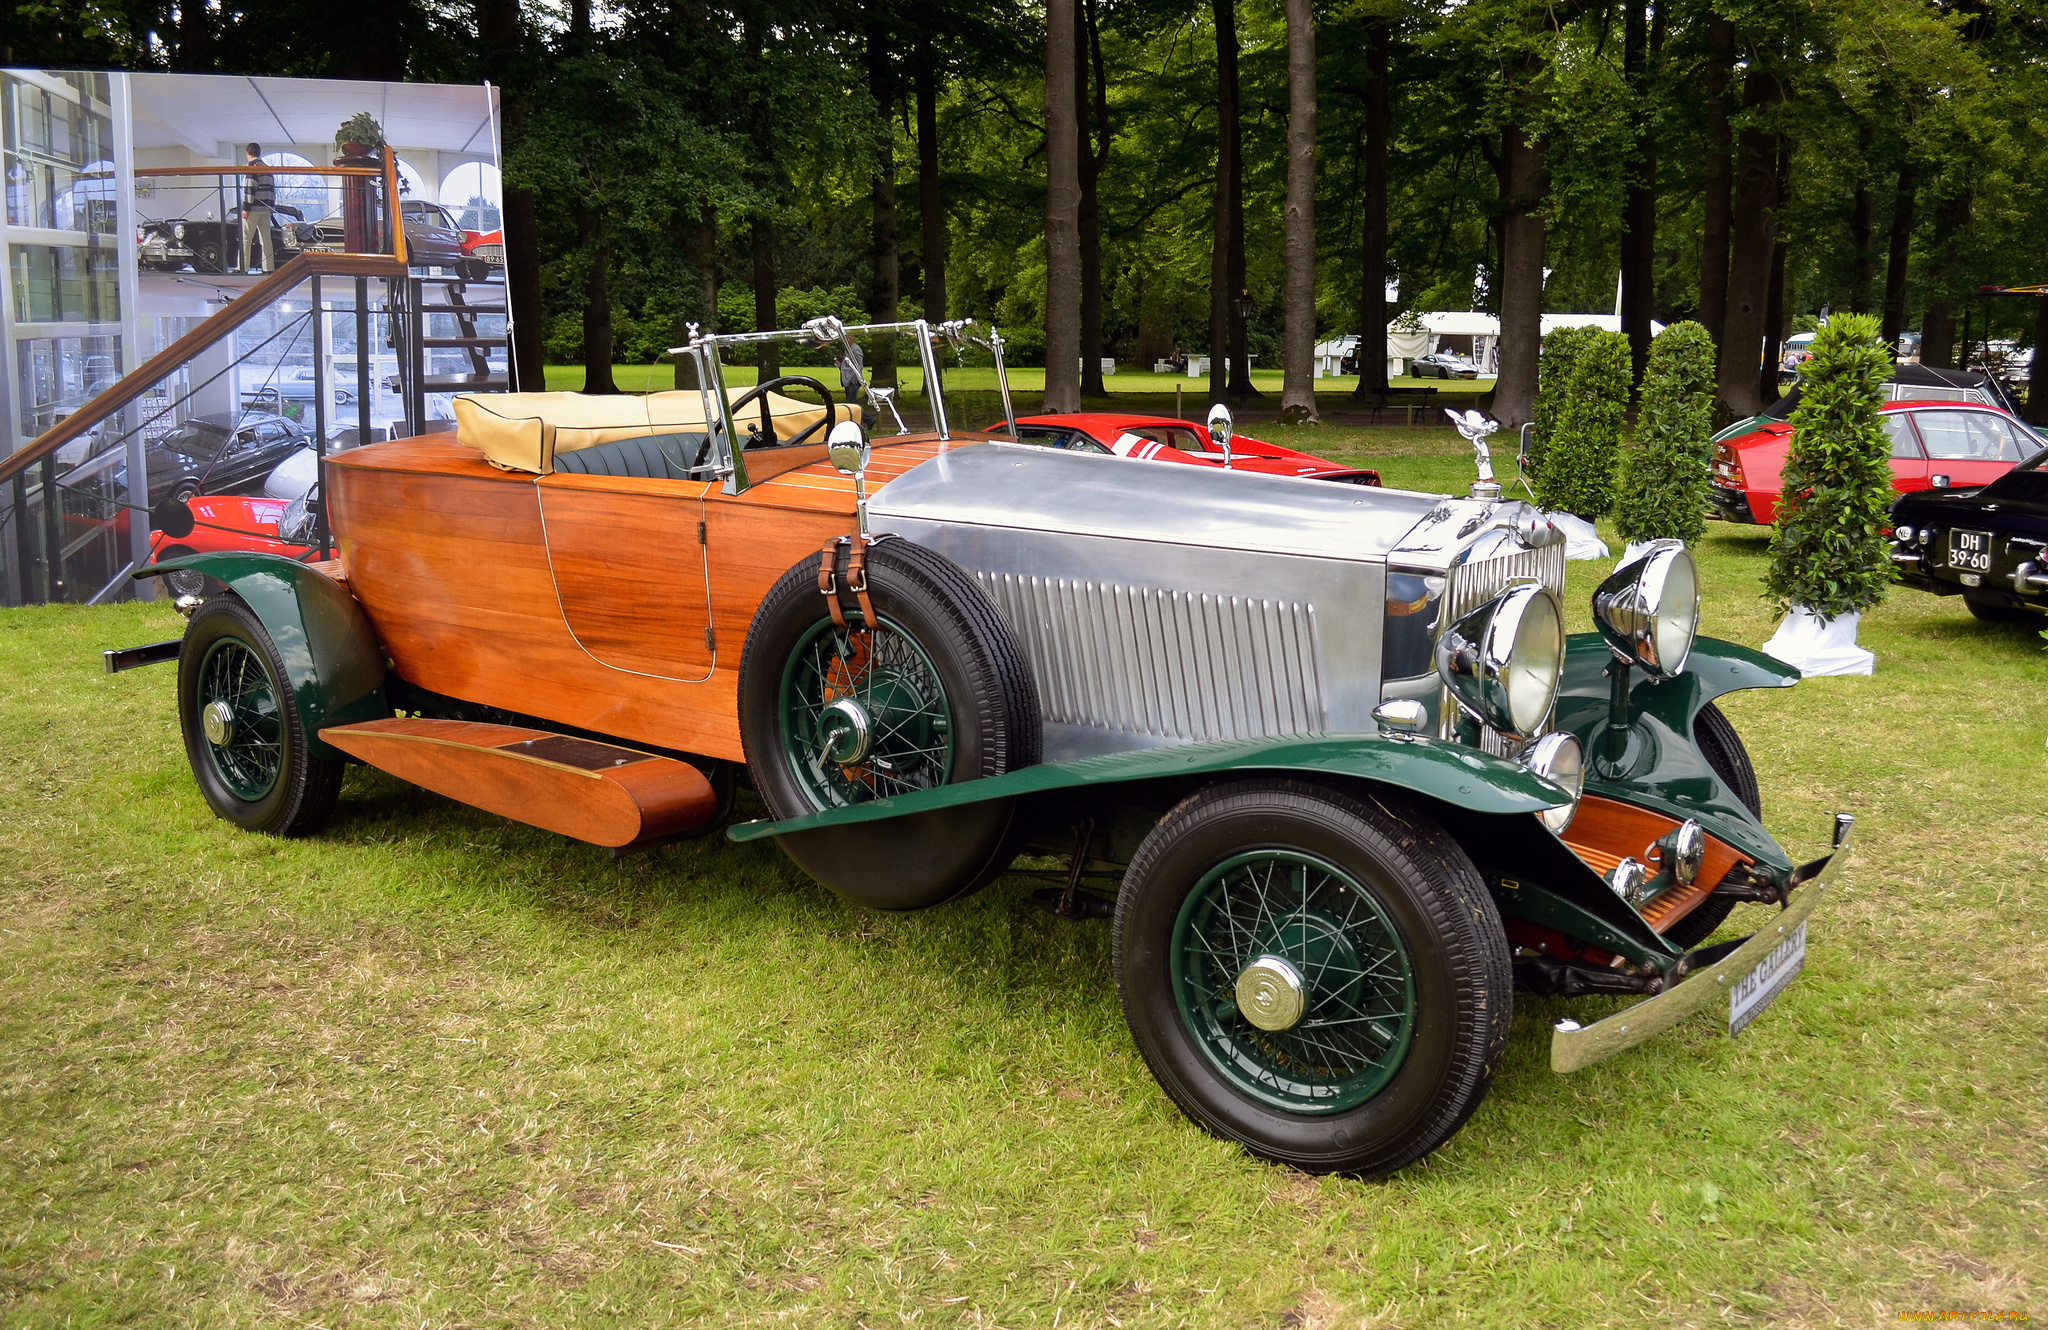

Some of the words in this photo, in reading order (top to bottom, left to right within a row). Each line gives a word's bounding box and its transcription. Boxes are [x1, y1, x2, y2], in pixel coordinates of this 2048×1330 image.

[1960, 533, 1979, 551] DH
[1950, 549, 1988, 569] 39-60
[1733, 967, 1757, 1007] THE
[1759, 923, 1805, 985] GALLERY
